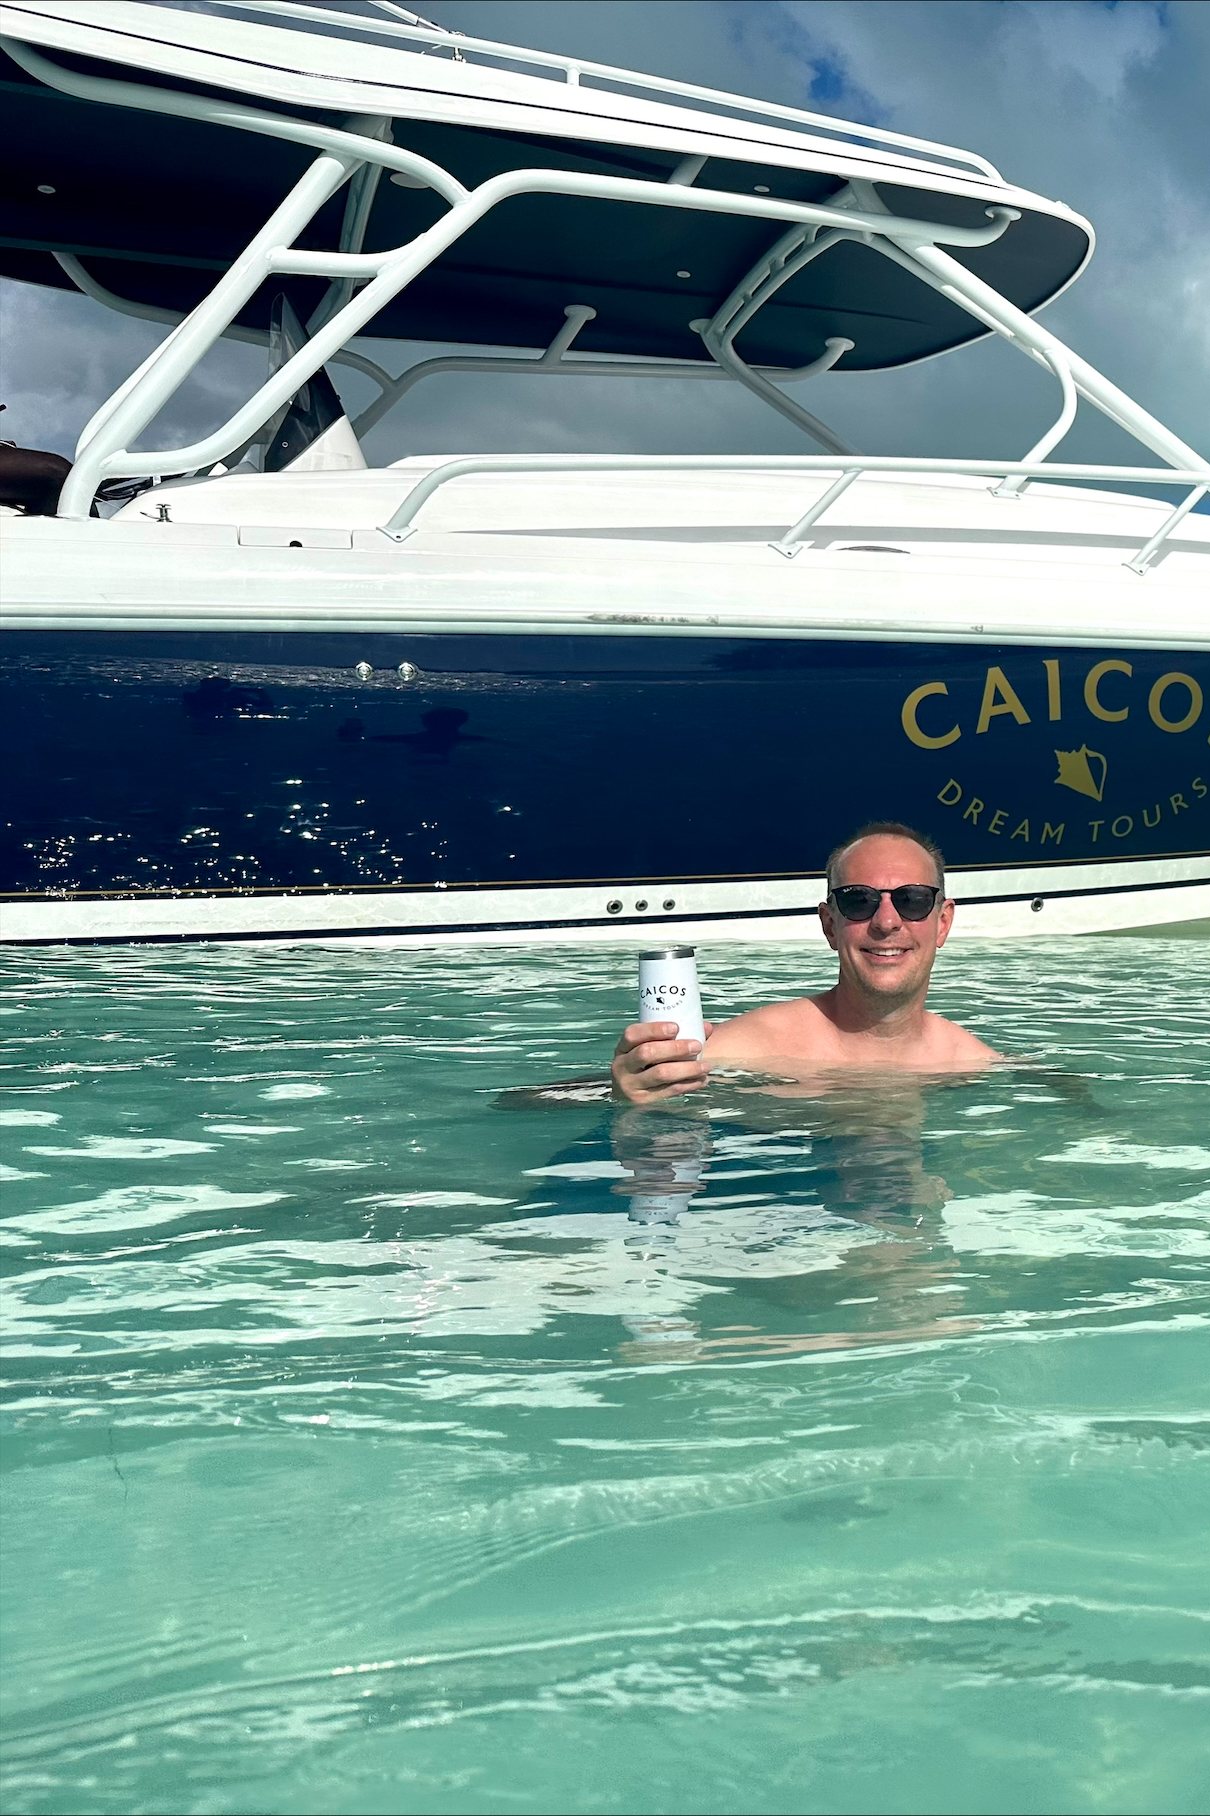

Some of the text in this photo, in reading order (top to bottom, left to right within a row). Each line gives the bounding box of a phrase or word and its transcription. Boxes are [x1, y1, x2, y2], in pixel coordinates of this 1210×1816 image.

[937, 777, 1208, 845] DREAM TOURS
[641, 985, 686, 998] CAICOS
